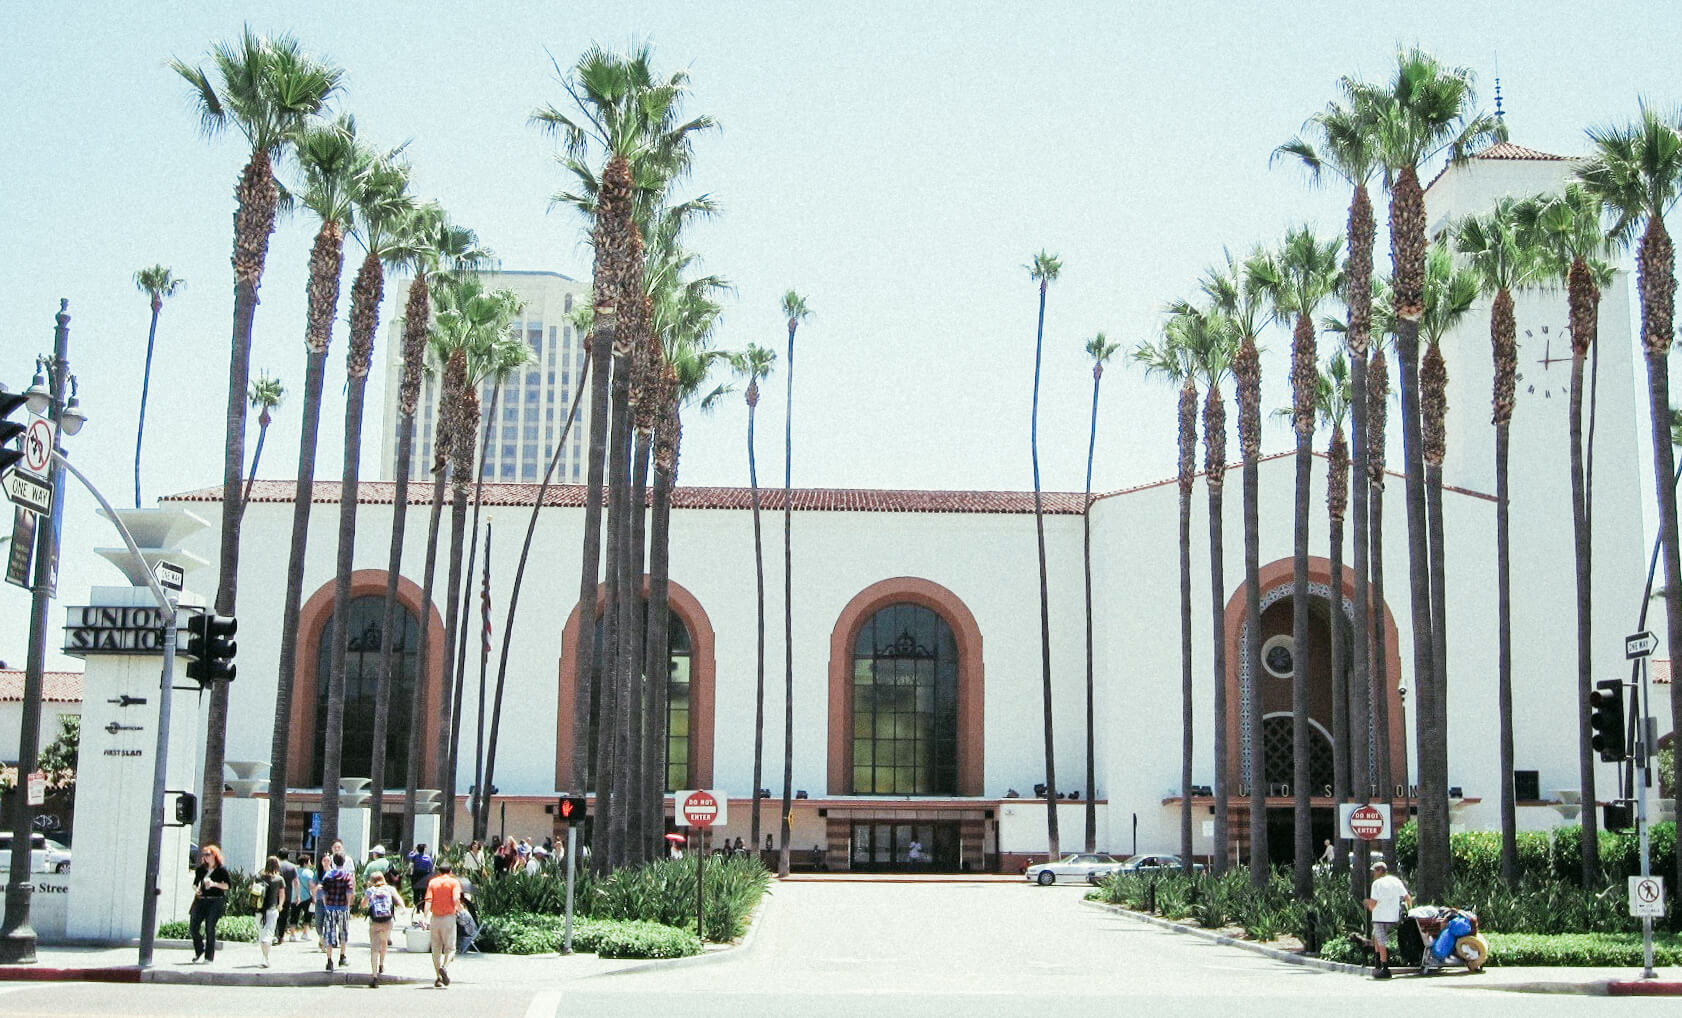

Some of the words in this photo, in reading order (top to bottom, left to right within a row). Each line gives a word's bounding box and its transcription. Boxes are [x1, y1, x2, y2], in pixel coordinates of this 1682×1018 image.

[12, 478, 28, 498] ONE
[32, 486, 48, 505] WAY
[72, 630, 162, 648] STATIO
[39, 882, 69, 893] Stree
